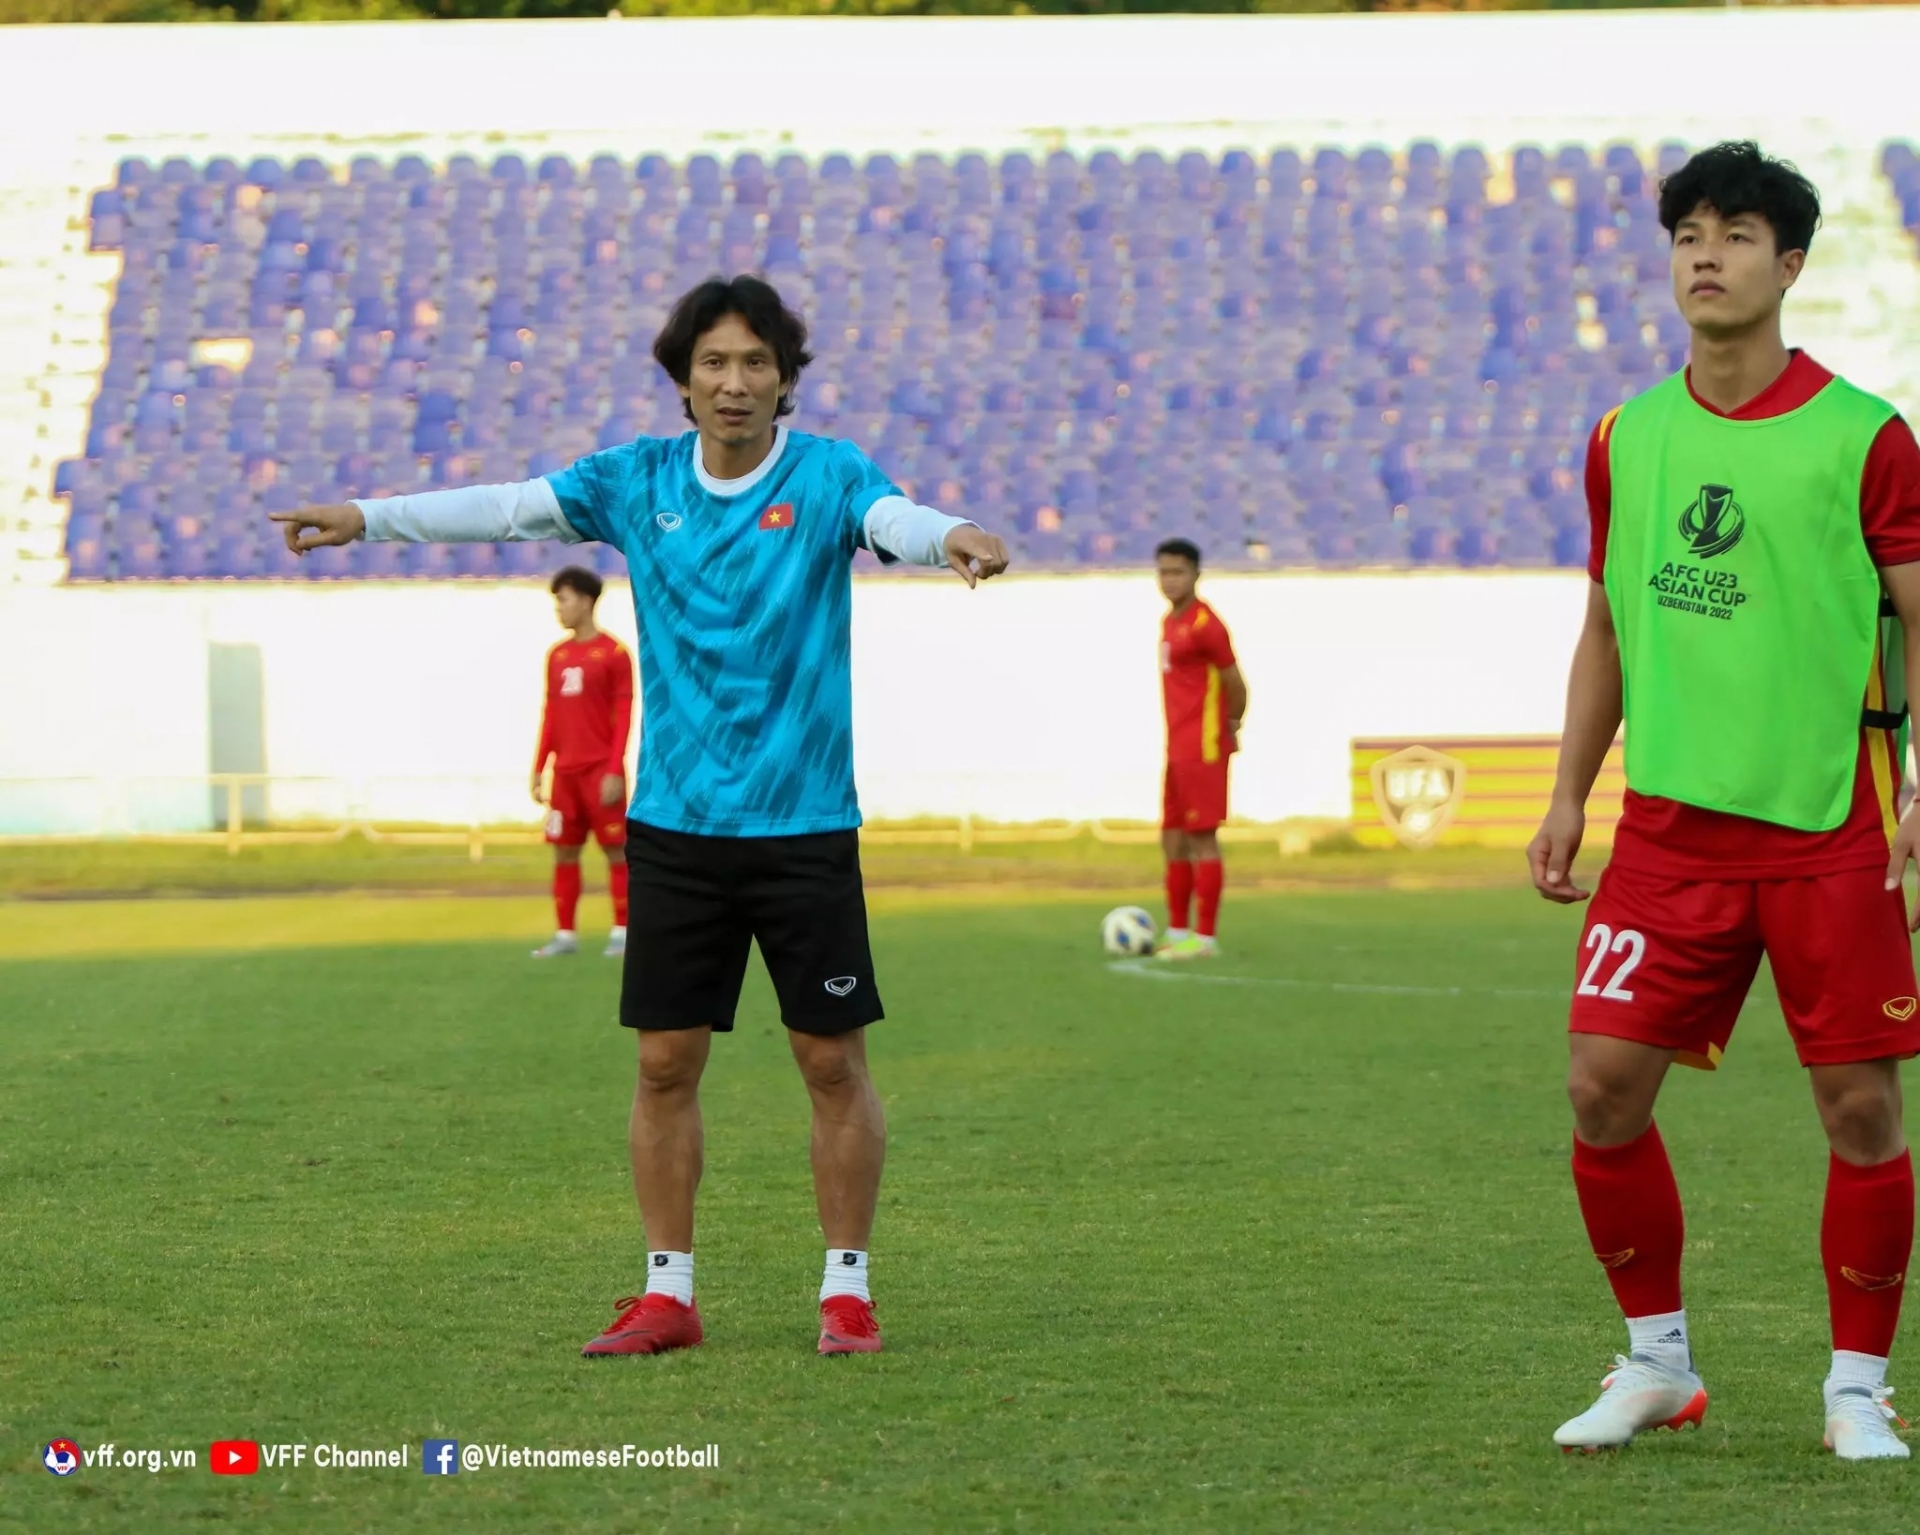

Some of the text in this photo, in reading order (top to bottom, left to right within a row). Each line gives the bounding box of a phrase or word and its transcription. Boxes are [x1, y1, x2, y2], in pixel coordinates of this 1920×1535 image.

[1648, 574, 1747, 607] ASIAN CUP
[1660, 562, 1738, 589] AFC U23
[1657, 595, 1733, 620] UZBEKISTAN 2022
[1577, 923, 1645, 1001] 22
